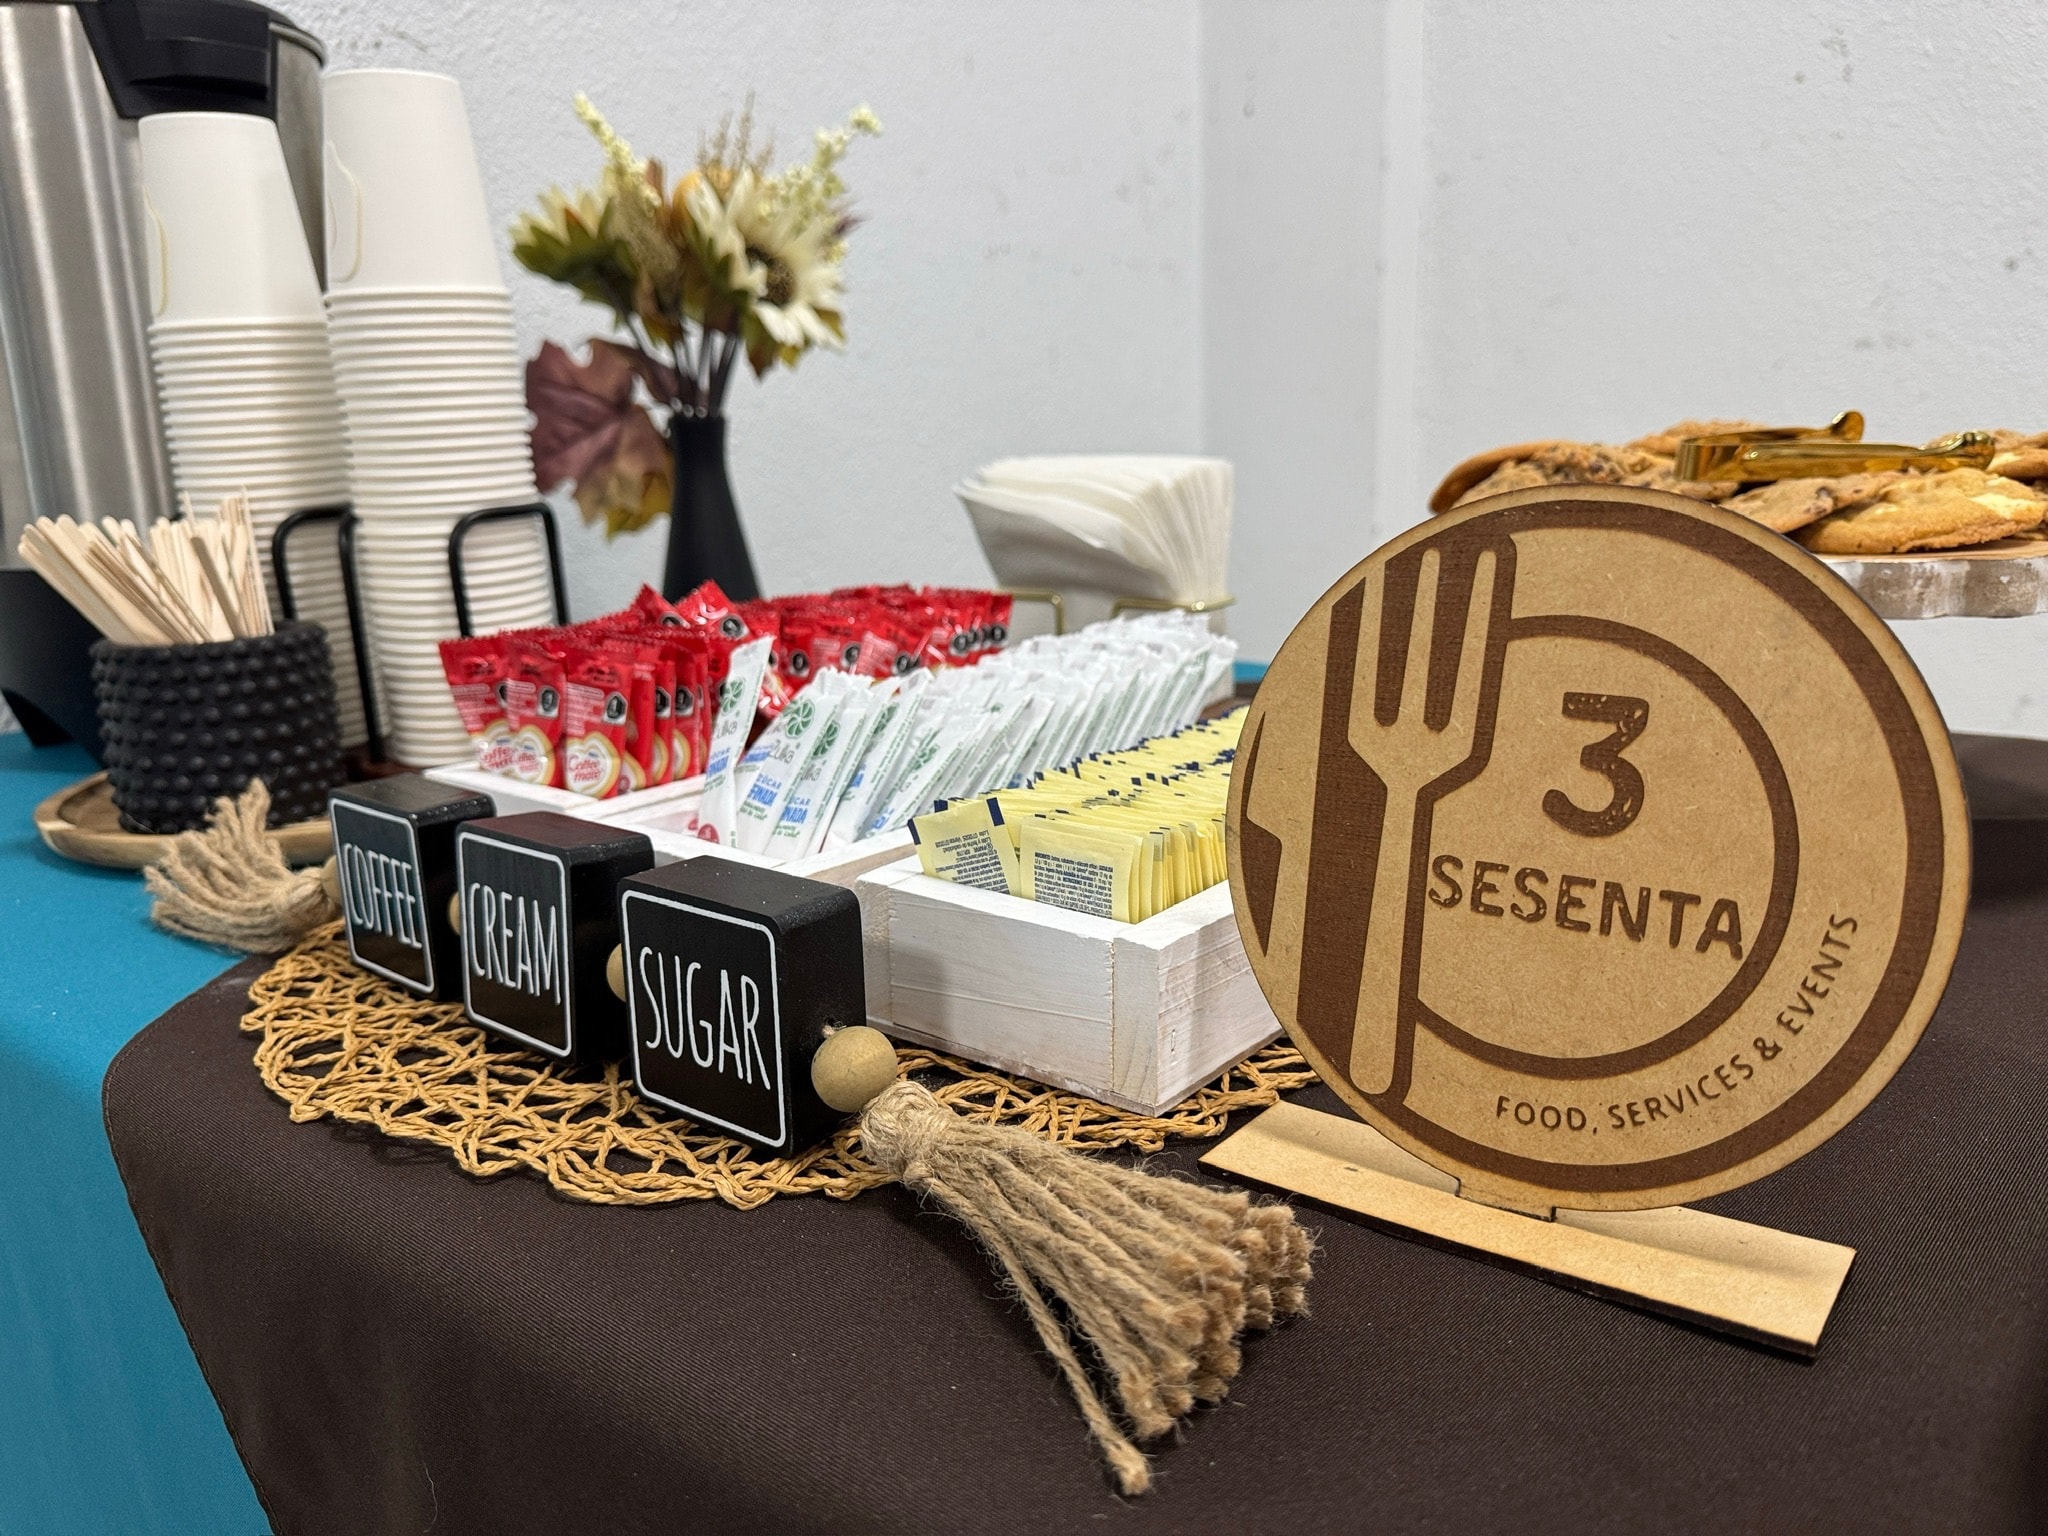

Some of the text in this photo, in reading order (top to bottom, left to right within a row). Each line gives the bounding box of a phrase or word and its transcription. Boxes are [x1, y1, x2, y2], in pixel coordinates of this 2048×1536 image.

[1542, 691, 1650, 838] 3
[342, 842, 423, 950] COFFEE
[467, 882, 562, 1006] CREAM
[1427, 854, 1744, 961] SESENTA
[638, 945, 771, 1091] SUGAR
[1496, 913, 1858, 1135] FOOD, SERVICES & EVENTS
